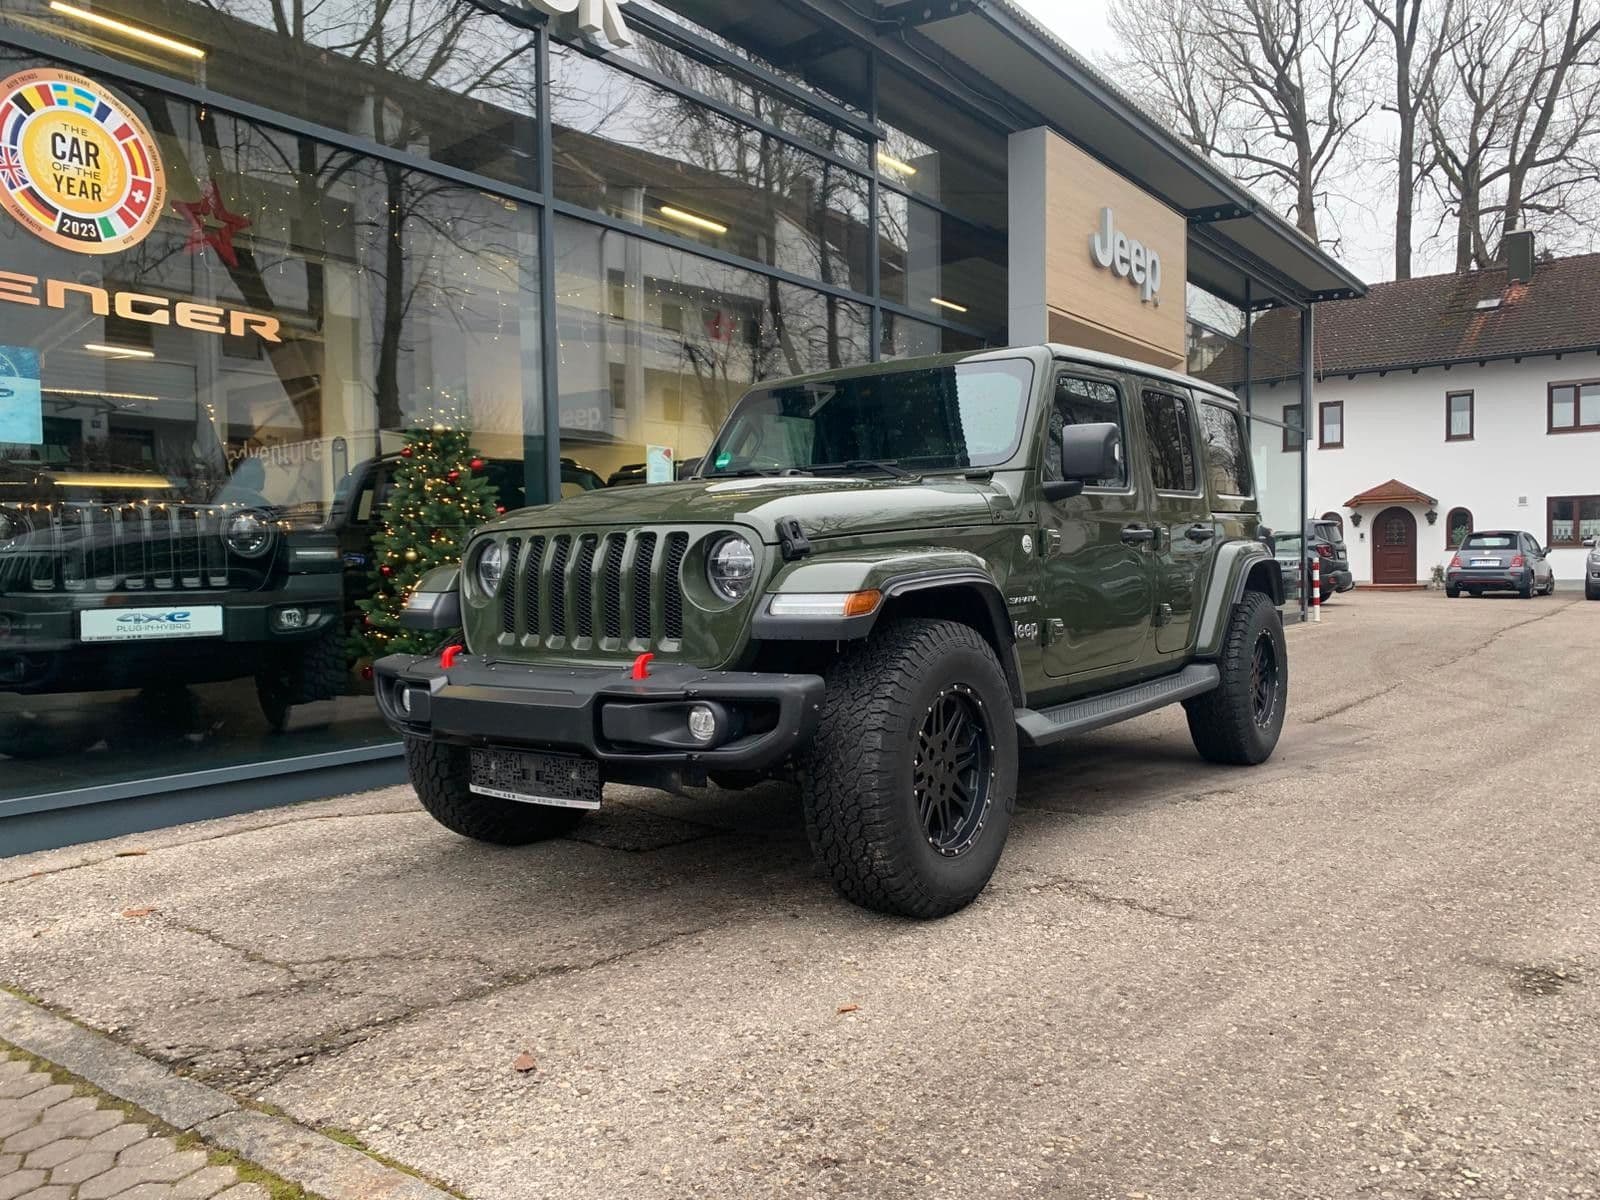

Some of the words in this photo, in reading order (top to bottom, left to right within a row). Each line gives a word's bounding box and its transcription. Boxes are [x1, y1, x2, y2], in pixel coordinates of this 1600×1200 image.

[61, 123, 88, 137] THE
[51, 132, 100, 169] CAR
[52, 161, 70, 172] OF
[74, 166, 101, 181] THE
[53, 173, 102, 202] YEAR
[62, 219, 97, 237] 2023
[1088, 208, 1161, 301] Jeep
[560, 408, 600, 427] eep
